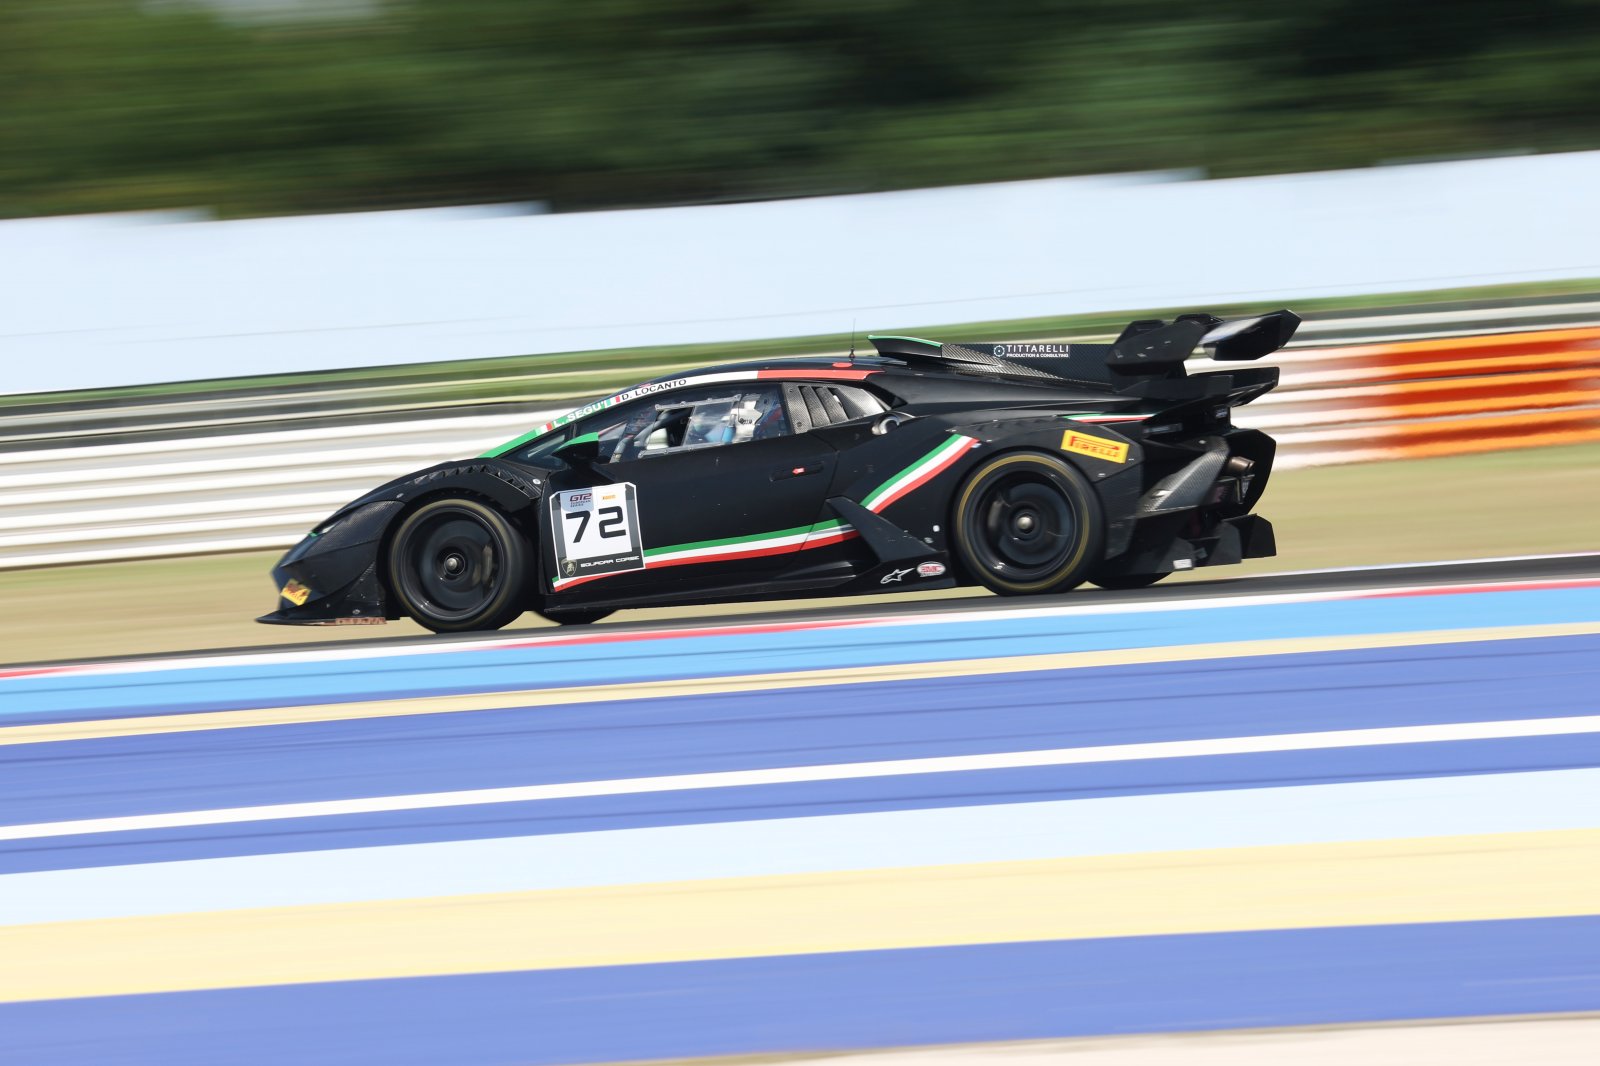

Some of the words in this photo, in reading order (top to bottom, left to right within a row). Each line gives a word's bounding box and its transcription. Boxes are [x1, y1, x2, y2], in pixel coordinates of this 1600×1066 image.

[1006, 344, 1069, 353] TITTARELLI
[634, 379, 687, 396] LOCANTO
[1069, 435, 1121, 458] PIRELLI
[570, 493, 592, 502] GT2
[565, 505, 626, 544] 72
[580, 559, 614, 568] SQUADRA
[615, 555, 640, 563] CORSE
